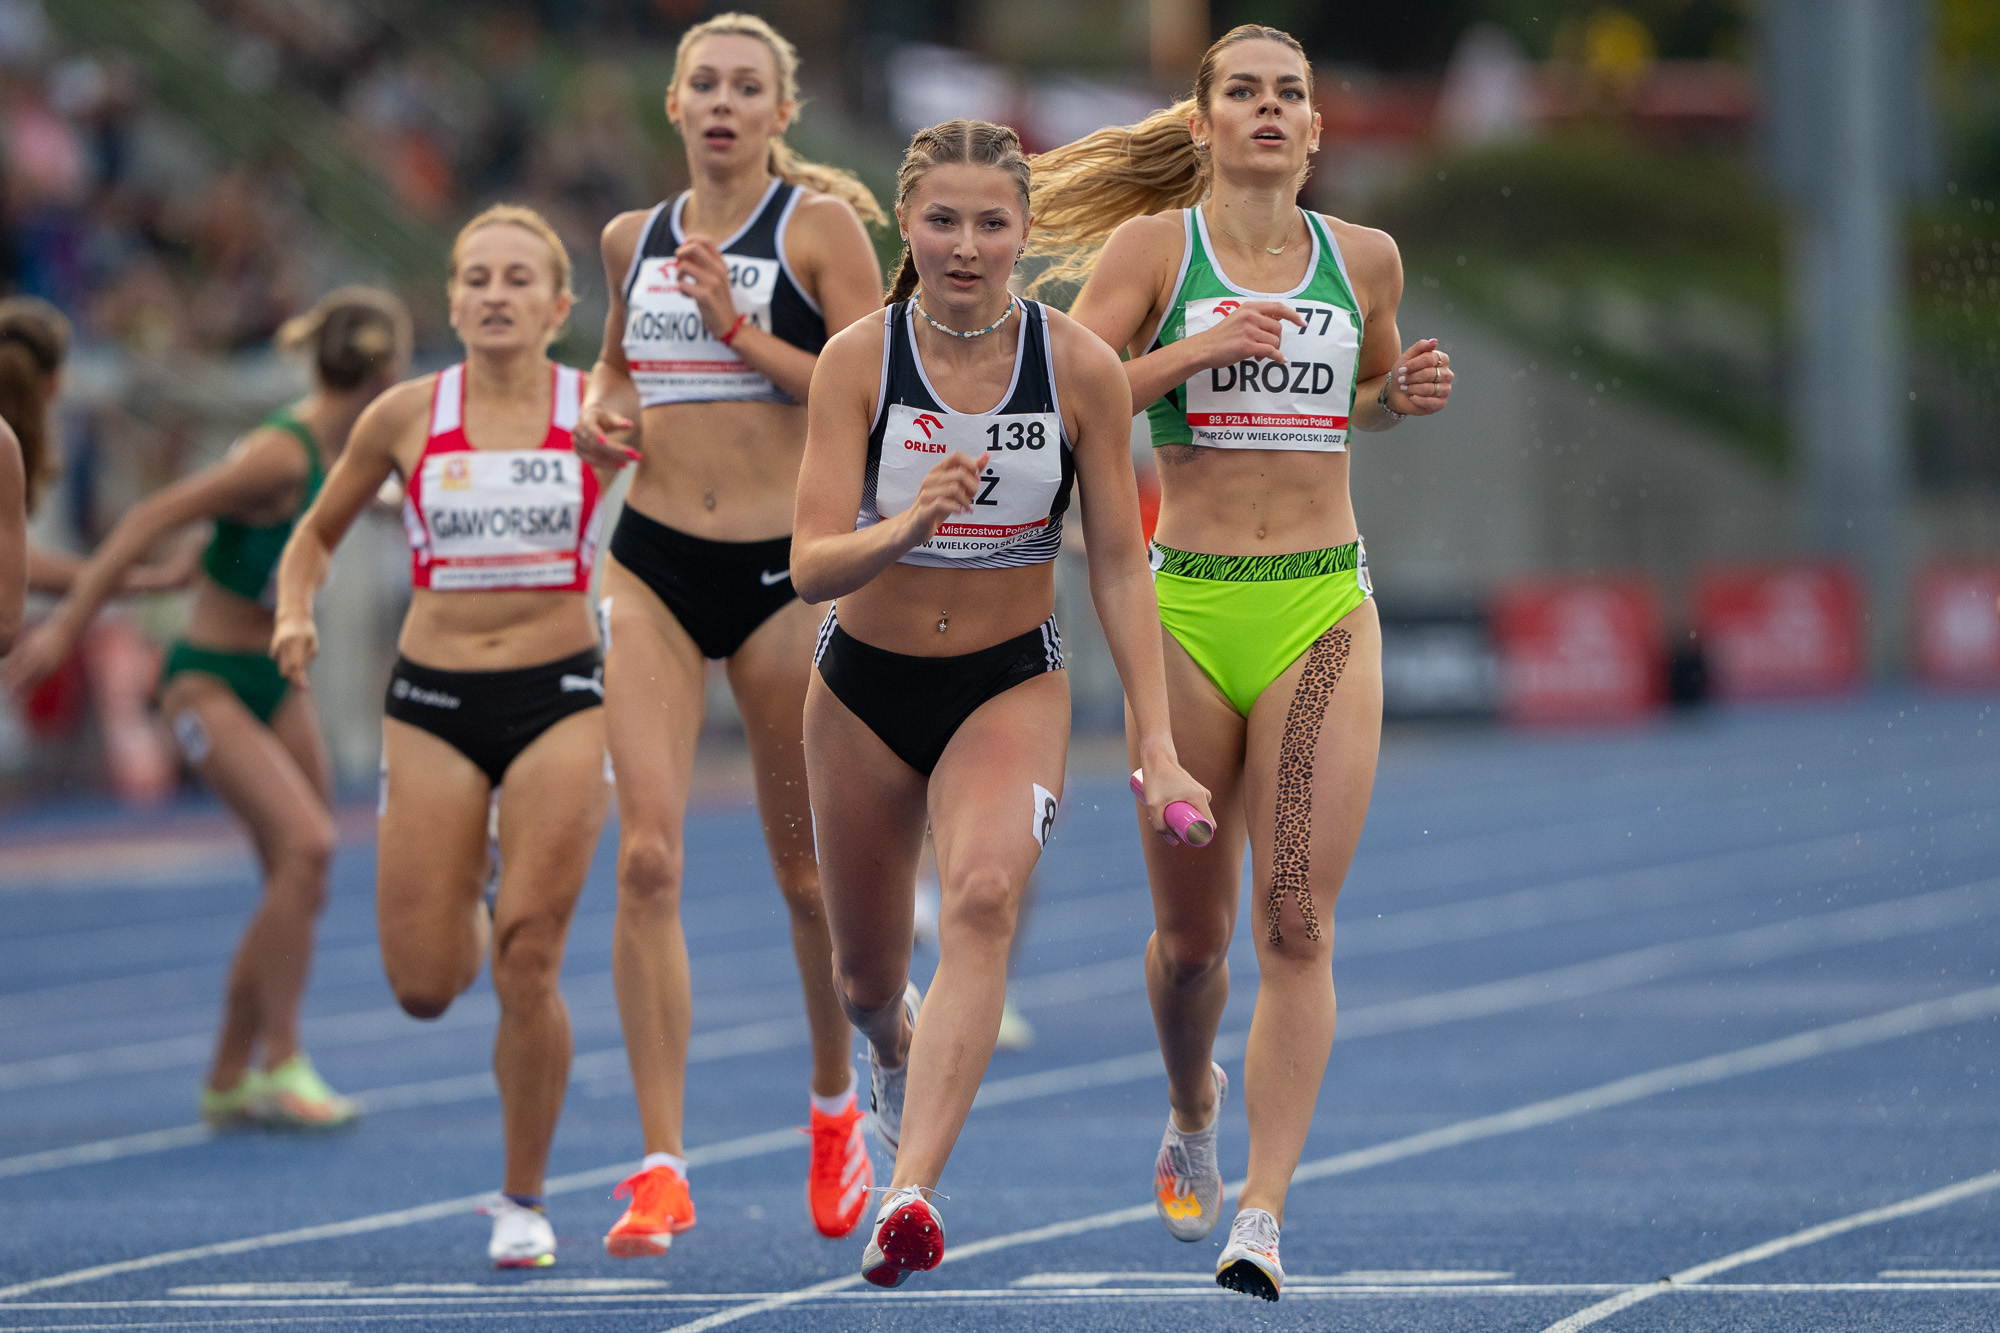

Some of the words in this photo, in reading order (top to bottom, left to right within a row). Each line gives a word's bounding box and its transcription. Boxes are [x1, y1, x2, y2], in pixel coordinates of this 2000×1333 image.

[1295, 307, 1333, 336] 77
[1211, 359, 1334, 395] DROZD
[1208, 415, 1224, 425] 99.
[1225, 415, 1250, 425] PZLA
[1251, 415, 1309, 427] Mistrzostwa
[1310, 417, 1333, 428] Polski
[904, 439, 947, 454] ORLEN
[986, 421, 1046, 451] 138
[1246, 432, 1322, 443] WIELKOPOLSKI
[1323, 434, 1341, 444] 2023
[510, 458, 567, 484] 301
[970, 468, 1000, 506] Ż
[431, 506, 573, 539] GAWORSKA
[942, 525, 1003, 536] Mistrzostwa
[936, 536, 1015, 551] WIELKOPOLSKI
[1016, 528, 1040, 542] 2023
[1041, 796, 1057, 848] 8
